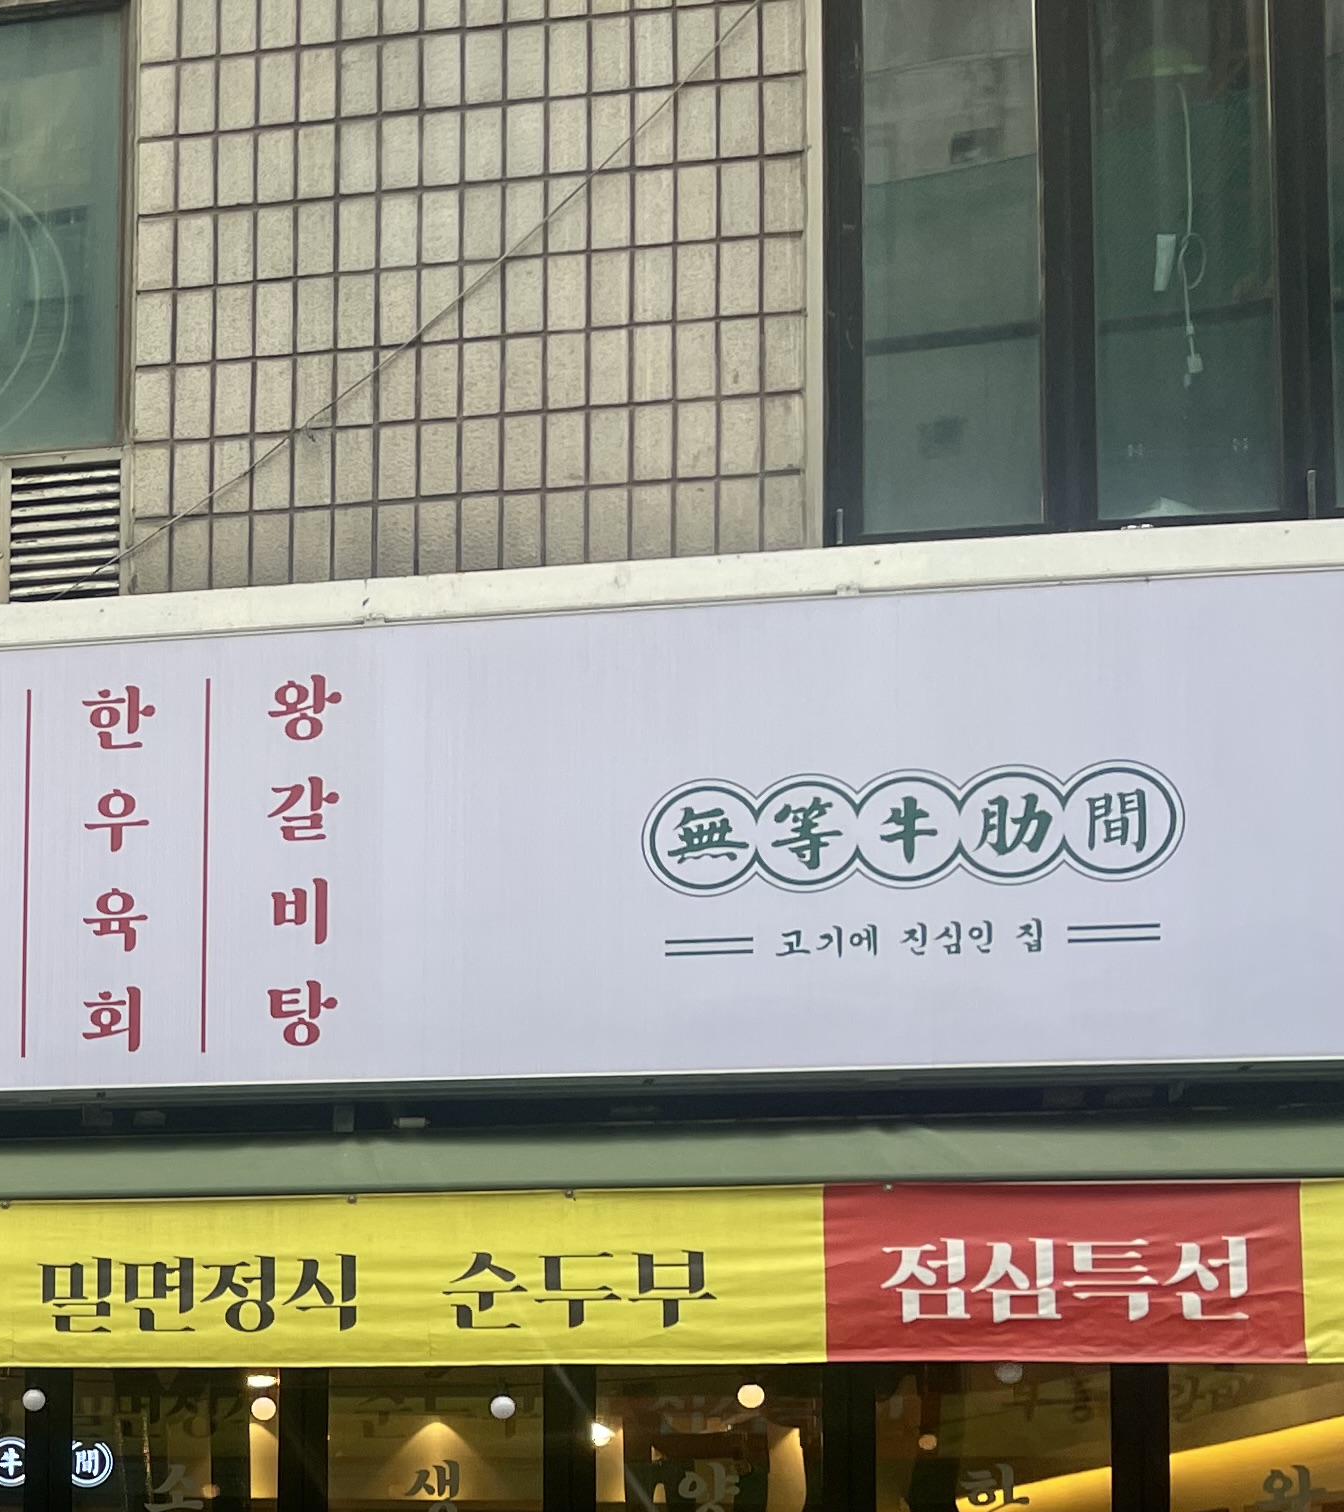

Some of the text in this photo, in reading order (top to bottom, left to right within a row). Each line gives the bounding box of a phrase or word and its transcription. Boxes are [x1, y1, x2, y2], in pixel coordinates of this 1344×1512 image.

[81, 685, 156, 1053] 한우육회
[266, 674, 343, 1048] 왕갈비탕
[775, 917, 1044, 958] 고기에 진심인 집
[37, 1252, 358, 1333] 밀면정식
[441, 1249, 716, 1329] 순두부
[880, 1236, 1249, 1323] 점심특선
